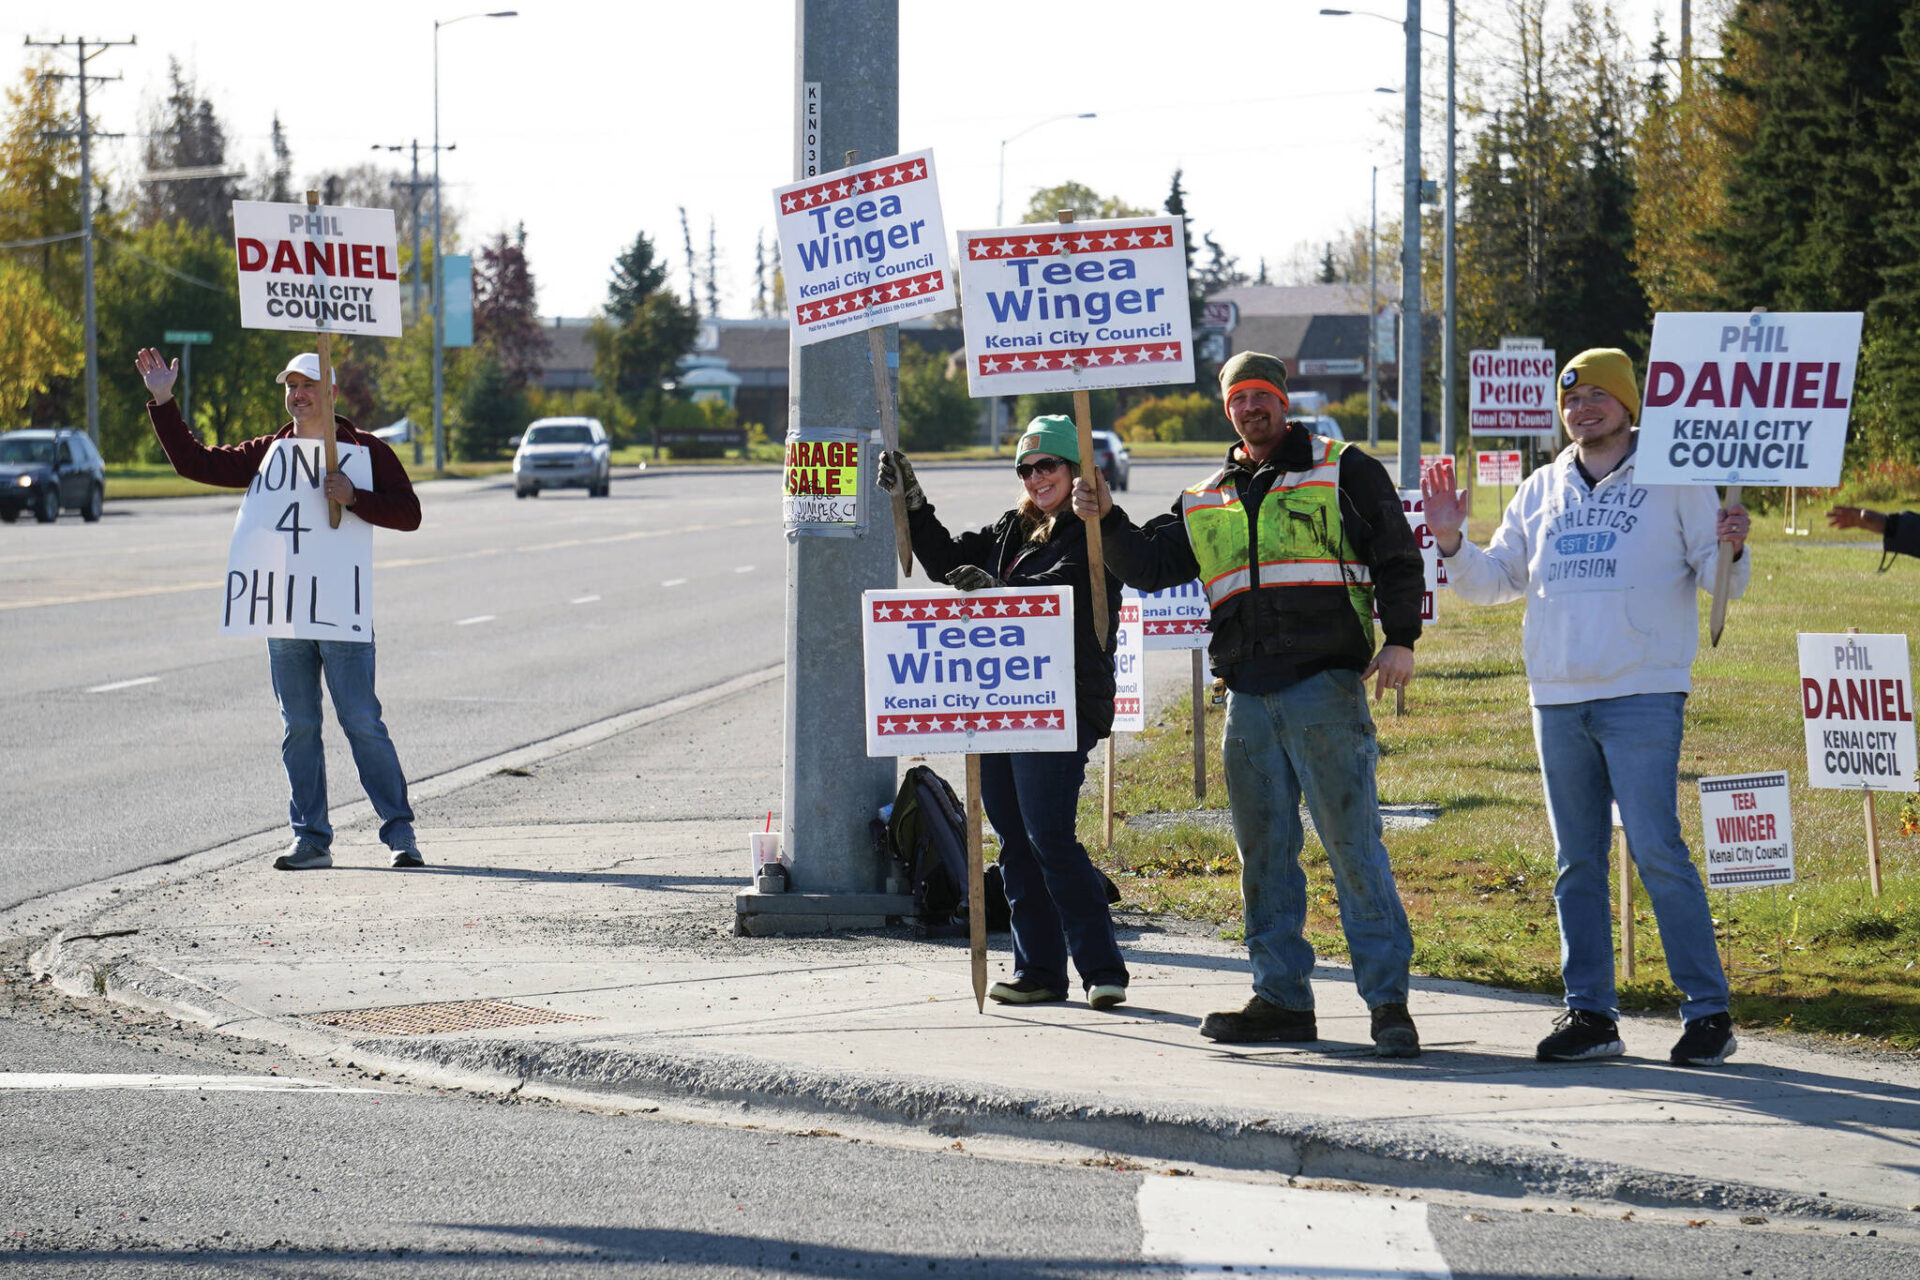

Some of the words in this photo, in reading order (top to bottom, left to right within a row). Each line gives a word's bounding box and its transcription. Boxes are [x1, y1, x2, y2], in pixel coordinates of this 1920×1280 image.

[288, 214, 344, 237] PHIL
[809, 194, 902, 235] Teea
[237, 237, 397, 281] DANIEL
[797, 219, 925, 273] Winger
[800, 276, 840, 298] Kenai
[844, 270, 870, 285] City
[875, 253, 934, 279] Council
[1006, 258, 1136, 287] Teea
[266, 281, 325, 300] KENAI
[329, 285, 374, 302] CITY
[266, 298, 377, 323] COUNCIL
[986, 287, 1165, 325] Winger
[985, 332, 1043, 349] Kenai
[1050, 330, 1089, 346] City
[1720, 326, 1789, 353] PHIL
[1472, 354, 1554, 378] Glenese
[1479, 381, 1545, 407] Pettey
[1645, 361, 1848, 409] DANIEL
[1473, 412, 1497, 426] Kenai
[1500, 412, 1517, 430] City
[1518, 412, 1551, 426] Council
[1672, 419, 1749, 440] KENAI
[1754, 420, 1813, 441] CITY
[1668, 442, 1810, 469] COUNCIL
[789, 469, 841, 495] SALE
[275, 502, 312, 555] 4
[1546, 508, 1638, 540] ATHLETICS
[1560, 538, 1583, 554] EST
[1586, 533, 1612, 553] 87
[1548, 558, 1617, 581] DIVISION
[1143, 606, 1171, 617] enai
[1176, 605, 1205, 617] City
[906, 622, 1026, 650] Teea
[887, 651, 1051, 690] Winger
[1834, 646, 1873, 671] PHIL
[1117, 682, 1138, 694] ouncil
[1802, 677, 1913, 722] DANIEL
[884, 695, 937, 709] Kenai
[943, 694, 980, 710] City
[1823, 730, 1864, 749] KENAI
[1866, 731, 1897, 750] CITY
[1825, 750, 1901, 776] COUNCIL
[1731, 792, 1757, 811] TEEA
[1716, 813, 1777, 844] WINGER
[1709, 848, 1734, 864] Kenai
[1736, 846, 1754, 863] City
[1755, 843, 1788, 860] Council
